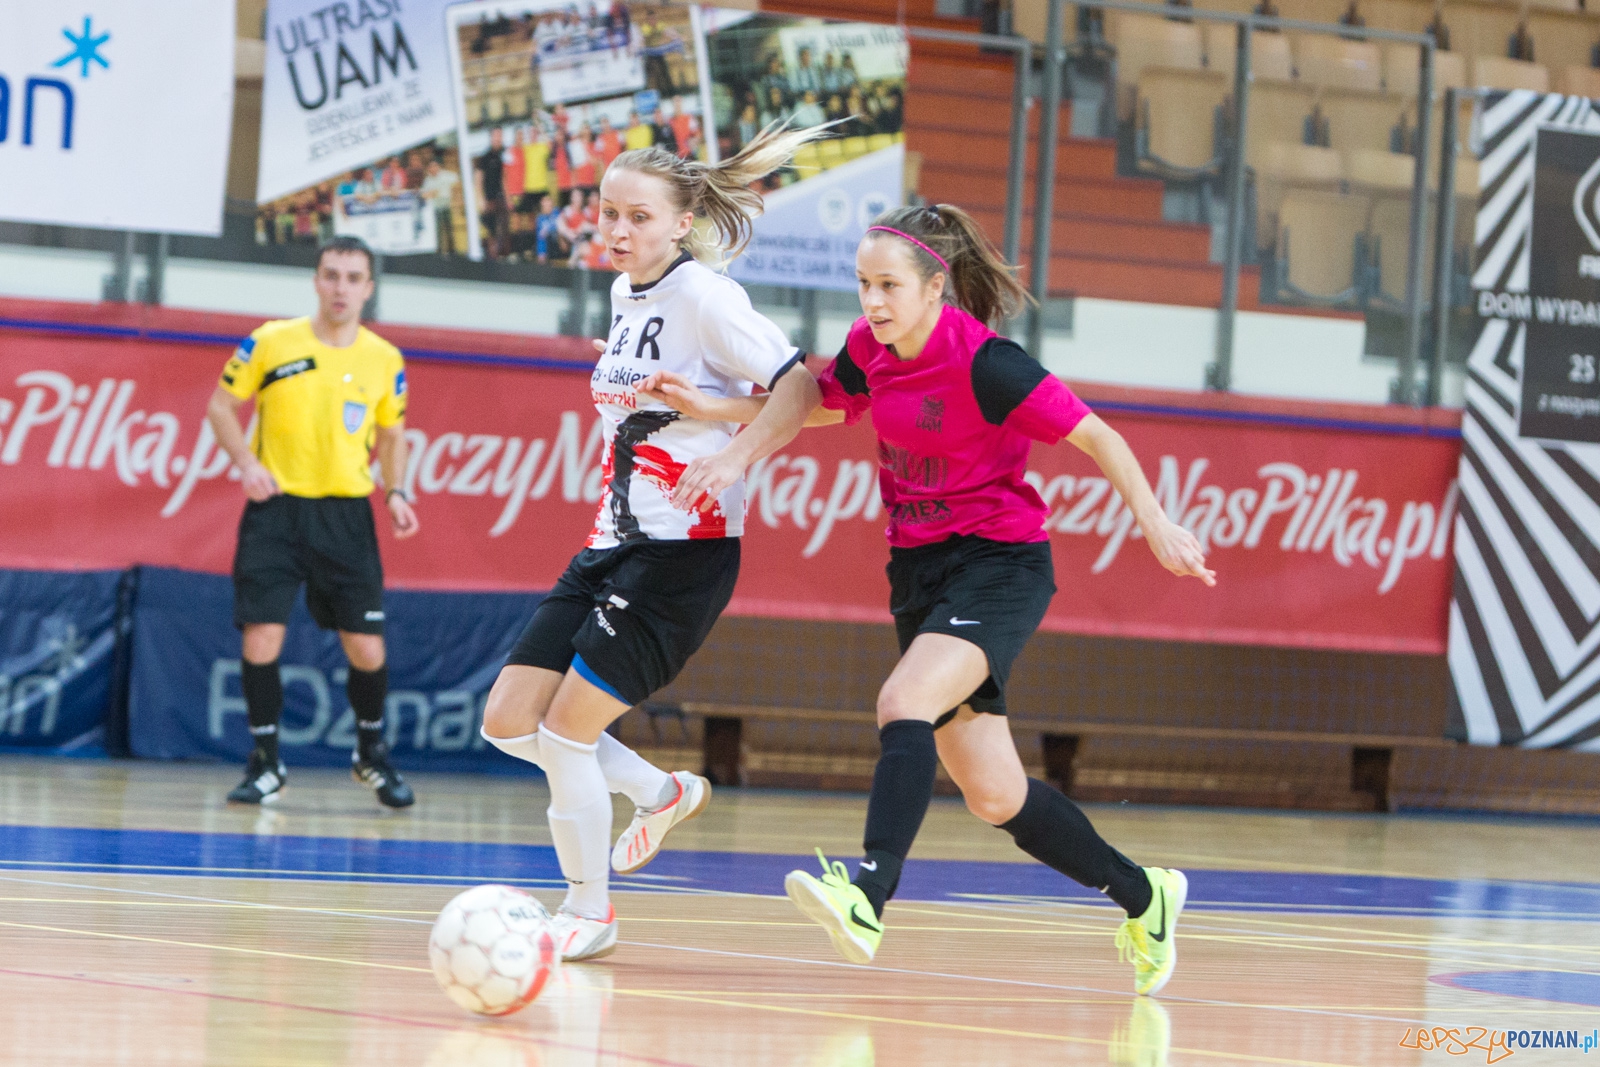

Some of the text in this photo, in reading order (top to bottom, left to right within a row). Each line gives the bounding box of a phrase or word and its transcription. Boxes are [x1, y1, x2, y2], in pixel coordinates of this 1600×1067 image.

[287, 19, 418, 111] UAM
[0, 74, 74, 149] n
[1478, 291, 1532, 319] DOM
[635, 316, 665, 361] R
[1569, 353, 1596, 384] 25
